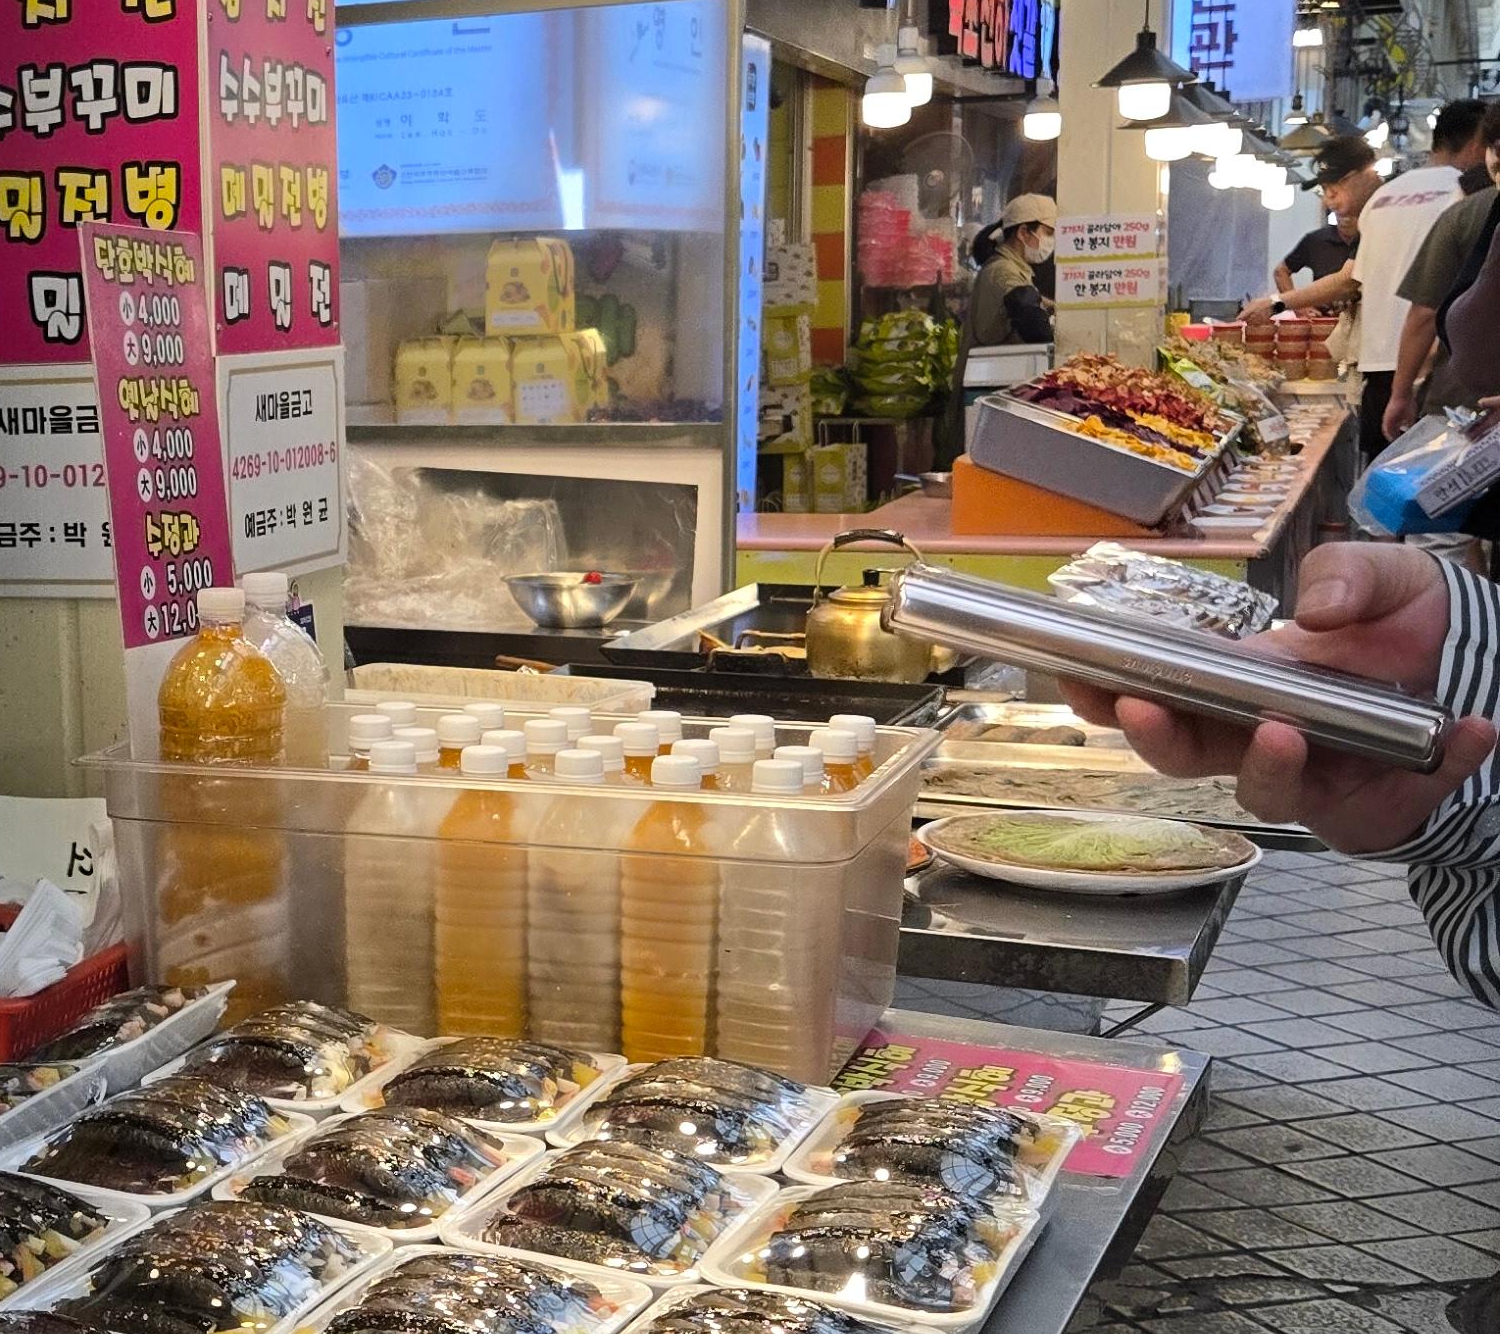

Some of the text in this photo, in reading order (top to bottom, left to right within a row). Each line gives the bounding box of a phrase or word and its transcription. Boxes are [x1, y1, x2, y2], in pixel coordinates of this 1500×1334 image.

[219, 51, 326, 129] 수수부꾸미
[221, 163, 329, 232] 메밀전병
[92, 233, 196, 287] 단호박식혜
[137, 292, 181, 327] 4,000
[141, 331, 185, 367] 9,000
[117, 375, 199, 424] 옛날식혜
[255, 389, 313, 423] 새마을금고
[150, 428, 194, 461] 4,000
[155, 469, 198, 501] 9,000
[145, 510, 200, 557] 수정과
[167, 558, 212, 596] 5,000
